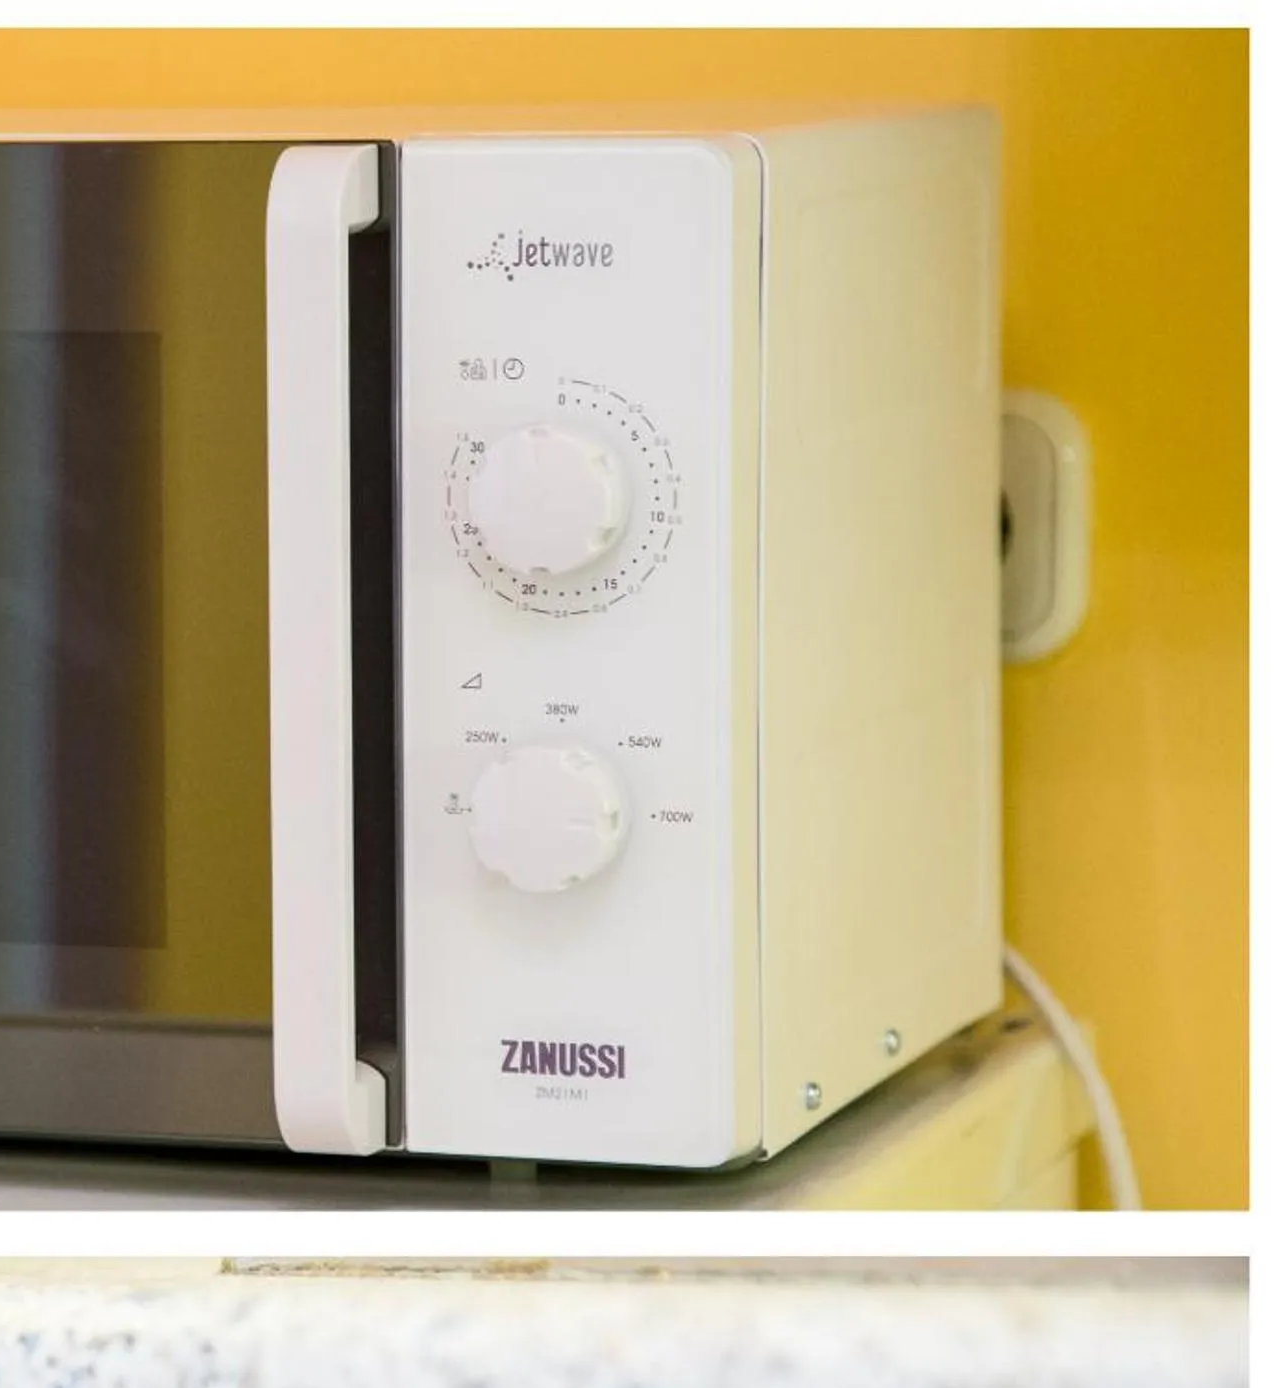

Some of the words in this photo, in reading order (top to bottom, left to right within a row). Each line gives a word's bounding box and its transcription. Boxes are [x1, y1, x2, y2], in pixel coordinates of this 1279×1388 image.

[512, 229, 614, 267] jetwave
[557, 393, 566, 406] 0
[630, 429, 640, 441] 5
[470, 441, 486, 454] 30
[650, 510, 665, 523] 10
[521, 583, 537, 596] 20
[603, 578, 618, 590] 15
[545, 703, 579, 716] 380W
[465, 730, 500, 744] 250W
[627, 735, 663, 748] 540W
[659, 810, 694, 823] 700W
[501, 1039, 626, 1080] ZANUSSI
